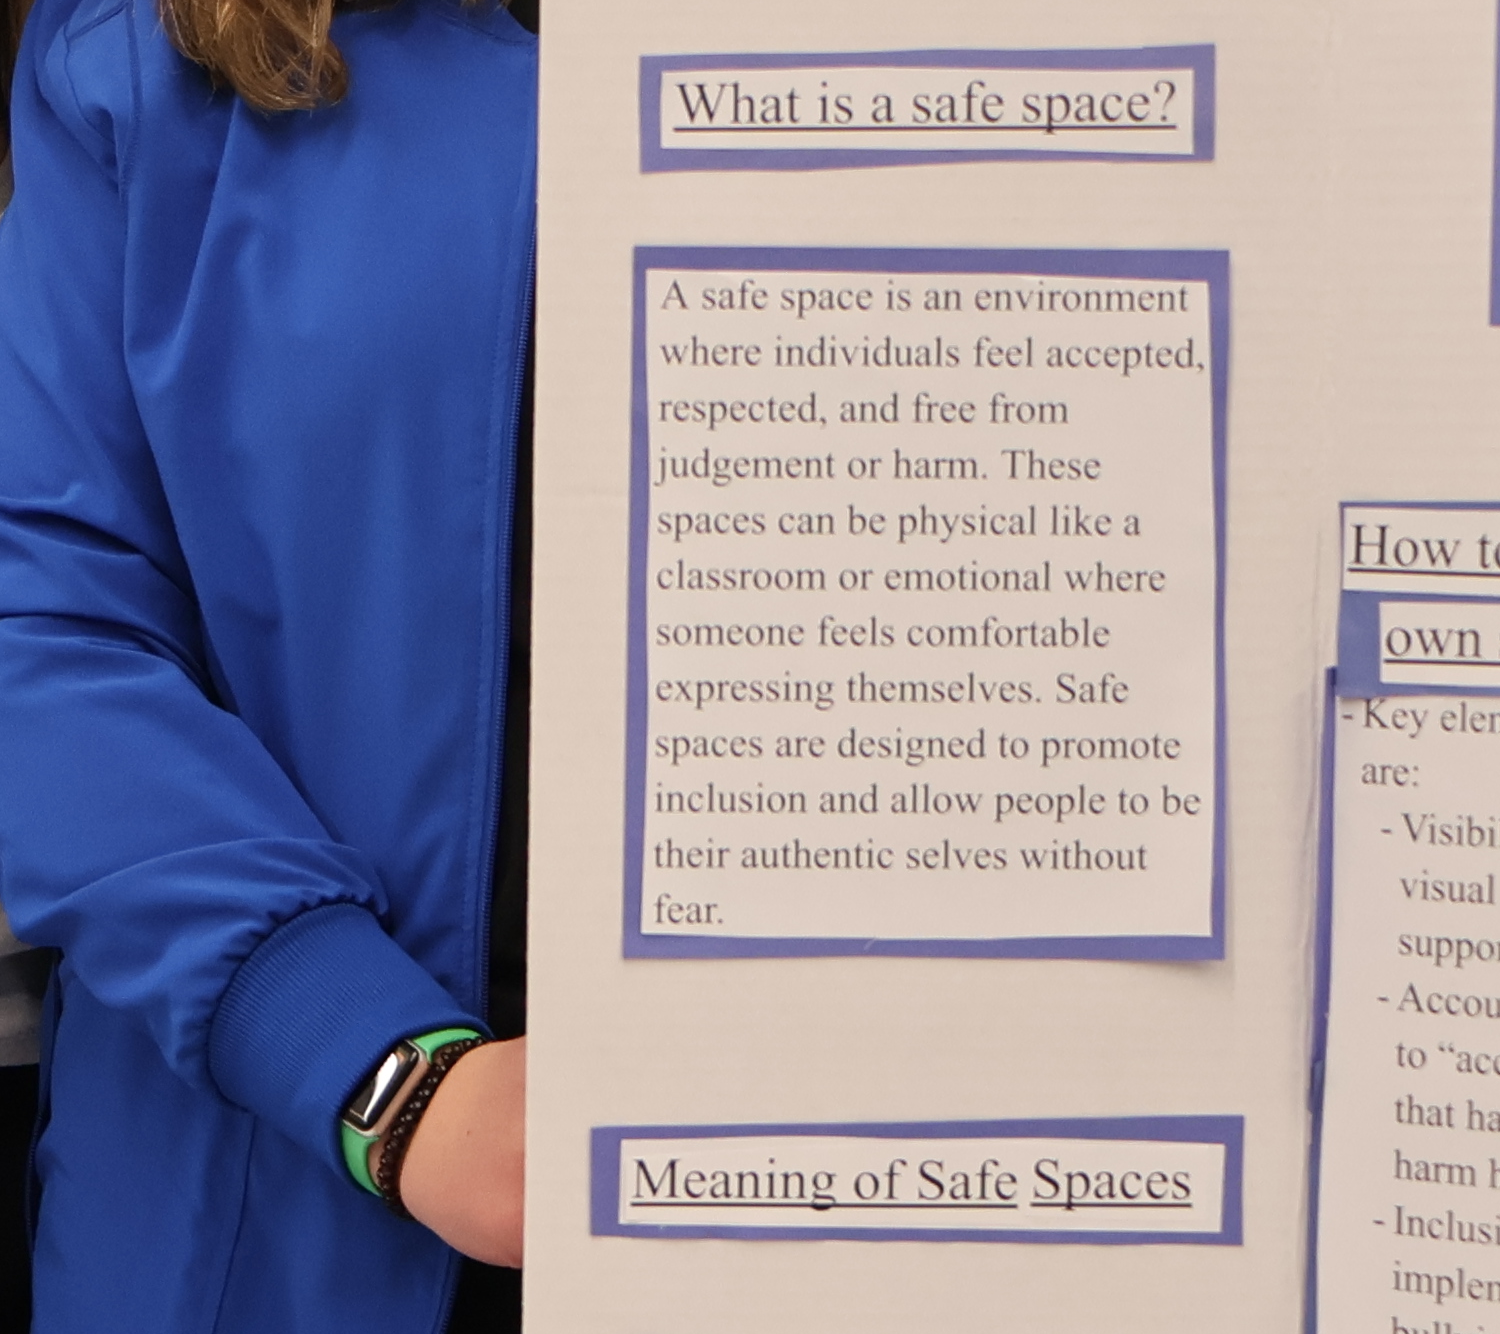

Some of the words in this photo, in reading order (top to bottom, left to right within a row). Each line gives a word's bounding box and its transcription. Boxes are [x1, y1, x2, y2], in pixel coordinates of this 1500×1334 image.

[676, 81, 802, 125] What
[818, 81, 853, 125] is
[871, 94, 895, 125] a
[911, 81, 1005, 125] safe
[1022, 80, 1178, 135] space?
[661, 278, 688, 309] A
[701, 278, 768, 310] safe
[780, 287, 873, 319] space
[886, 278, 912, 311] is
[922, 288, 962, 311] an
[973, 280, 1187, 312] environment
[659, 334, 761, 366] where
[774, 334, 960, 368] individuals
[973, 335, 1033, 368] feel
[1045, 336, 1205, 377] accepted,
[1350, 523, 1461, 569] How
[1385, 626, 1482, 660] own
[1398, 868, 1495, 905] visual
[631, 1157, 838, 1212] Meaning
[853, 1157, 906, 1201] of
[917, 1158, 1018, 1201] Safe
[1031, 1158, 1193, 1211] Spaces
